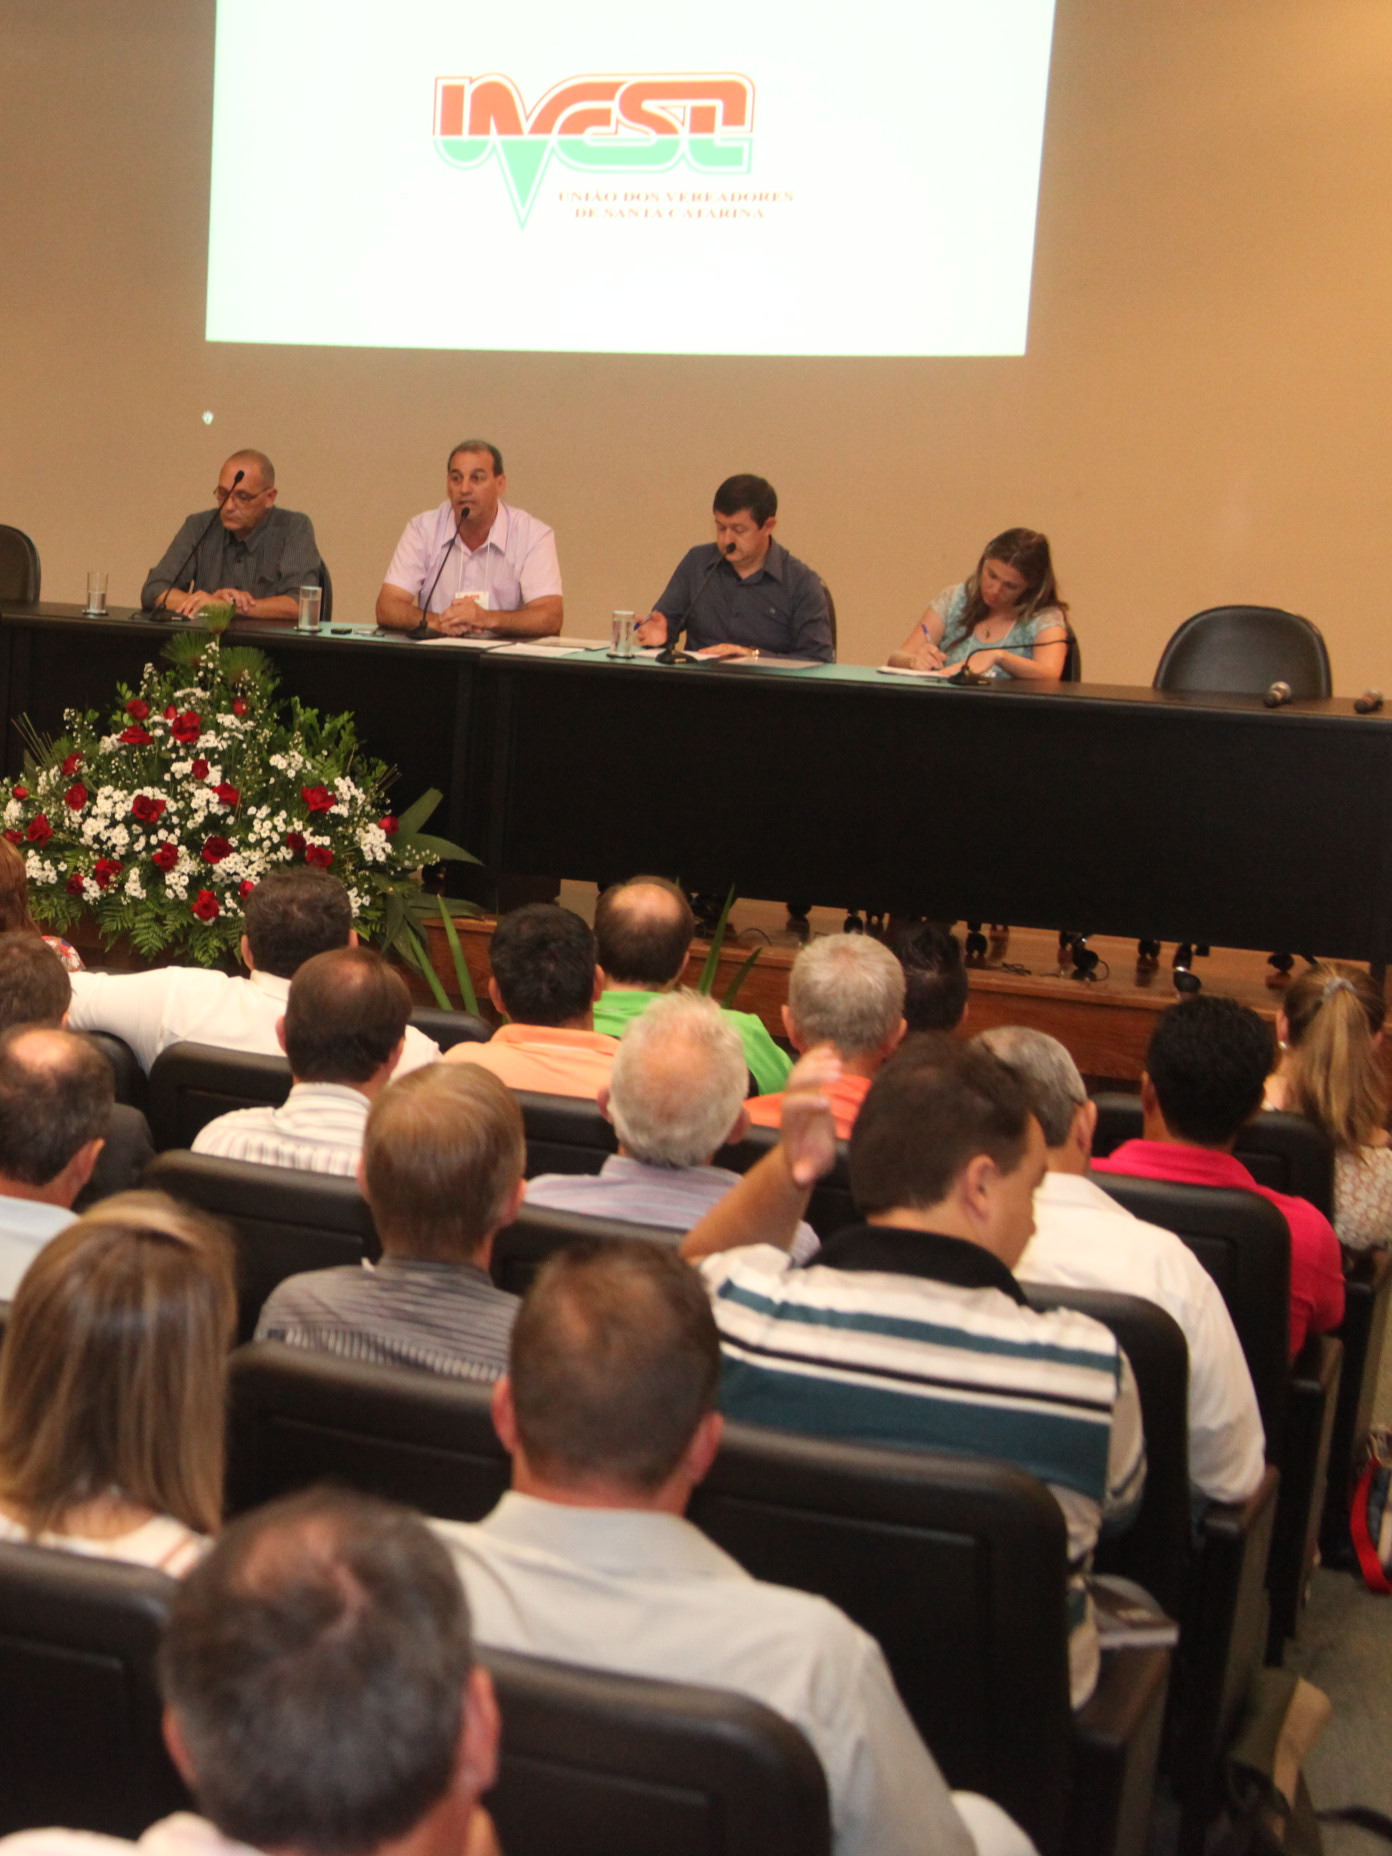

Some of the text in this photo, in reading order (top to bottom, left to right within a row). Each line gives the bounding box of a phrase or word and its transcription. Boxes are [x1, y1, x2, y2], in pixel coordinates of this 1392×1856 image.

[558, 188, 795, 203] UNIÃO DOS VEREADORES
[574, 207, 767, 220] DE SANTA CATARINA
